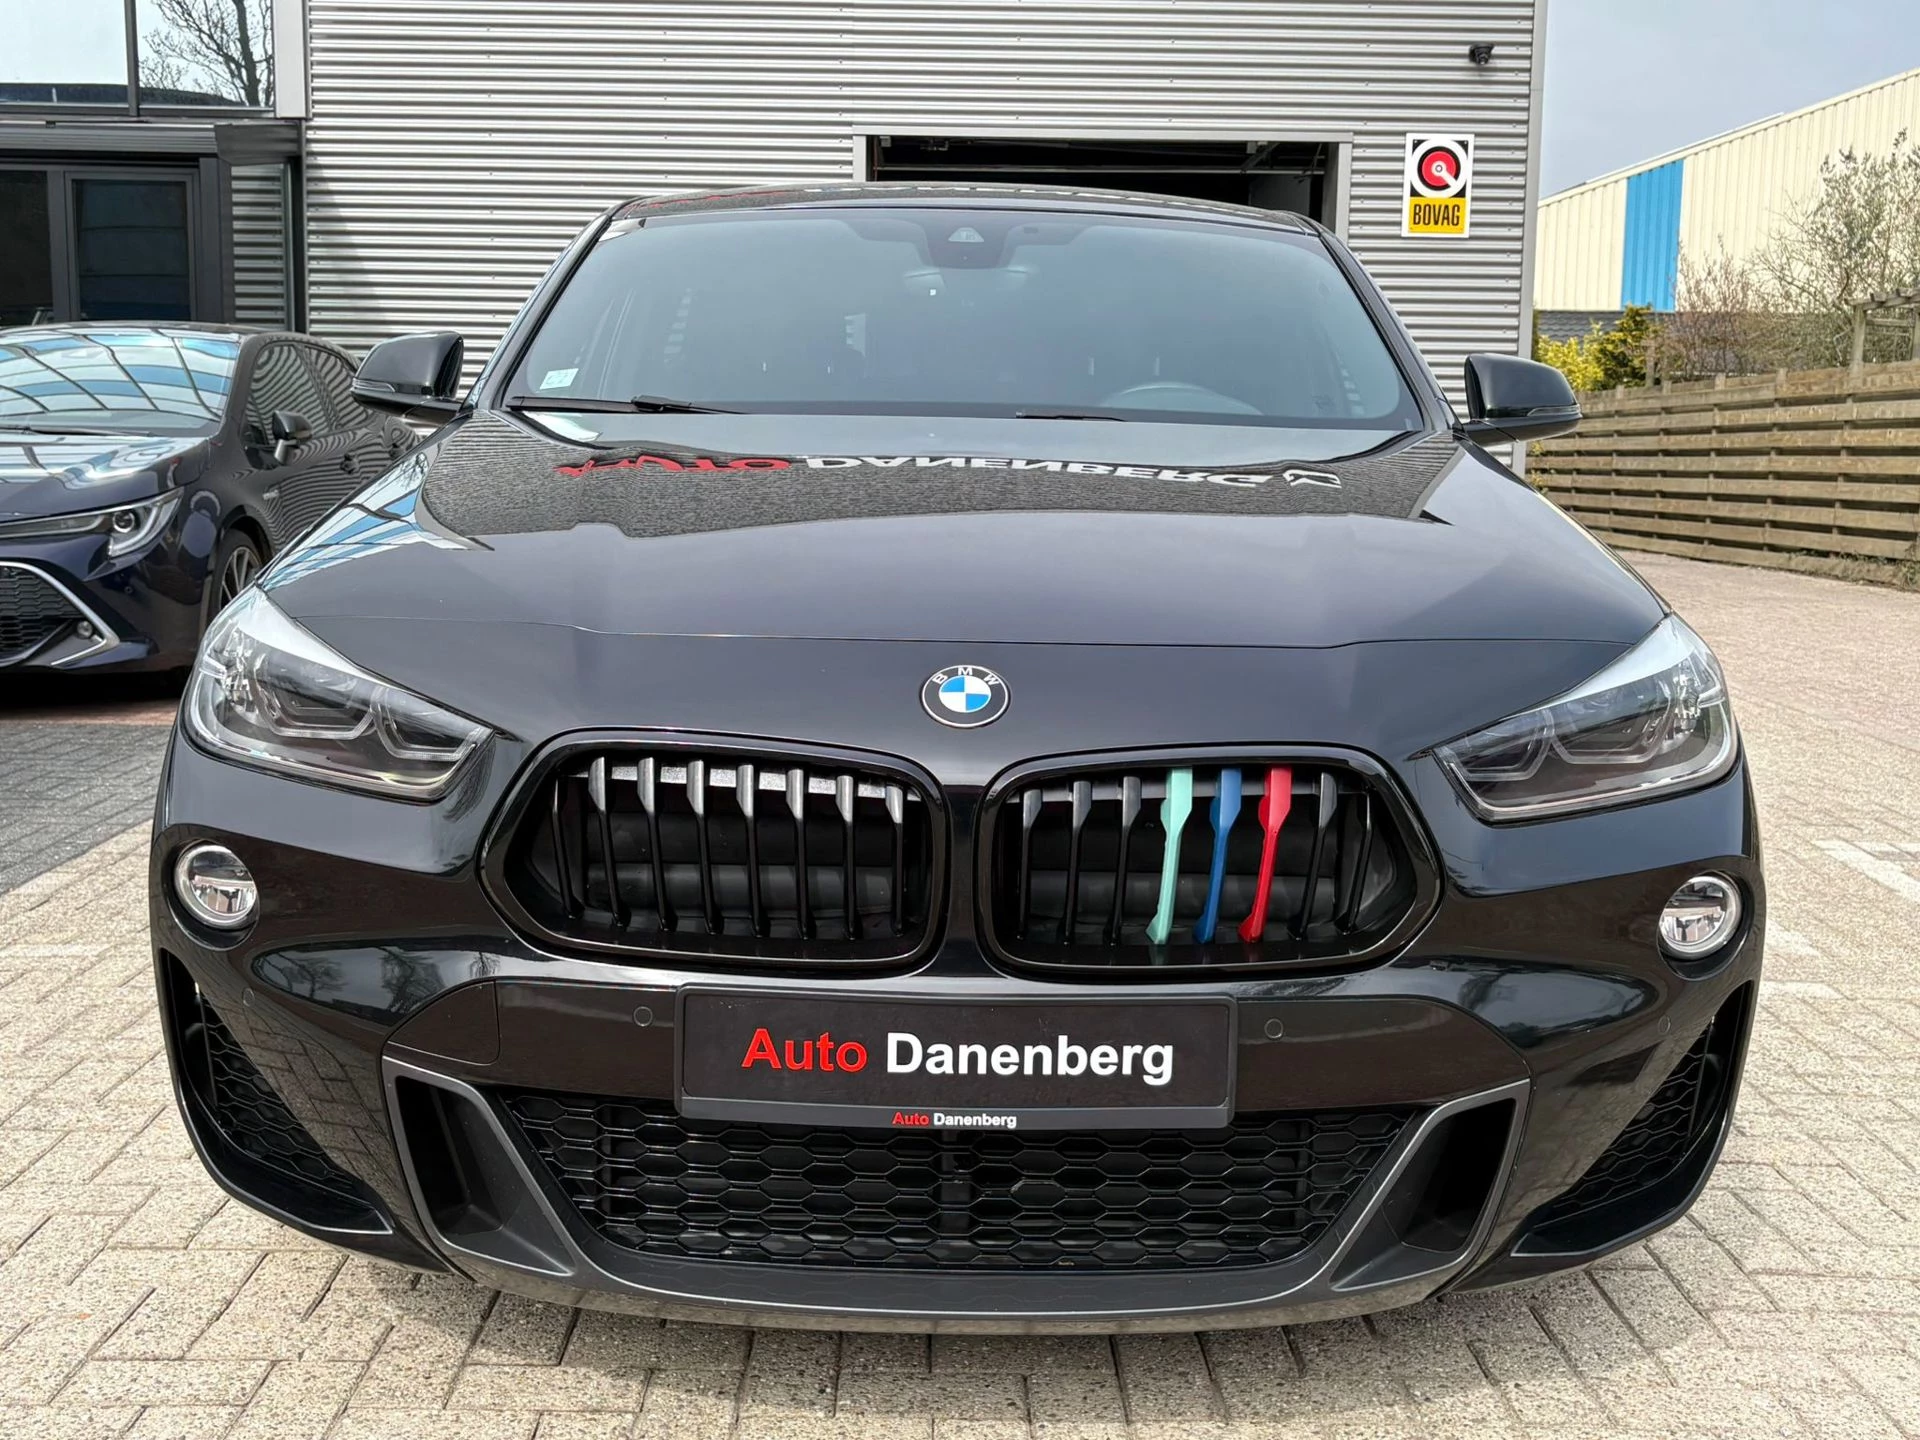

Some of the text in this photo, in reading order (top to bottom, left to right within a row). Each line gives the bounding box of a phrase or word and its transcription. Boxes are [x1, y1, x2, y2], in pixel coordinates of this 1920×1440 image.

[1413, 203, 1461, 226] BOVAG
[932, 666, 1000, 686] BMW
[741, 1027, 1174, 1086] Auto Danenberg
[892, 1111, 1017, 1130] Auto Danenberg
